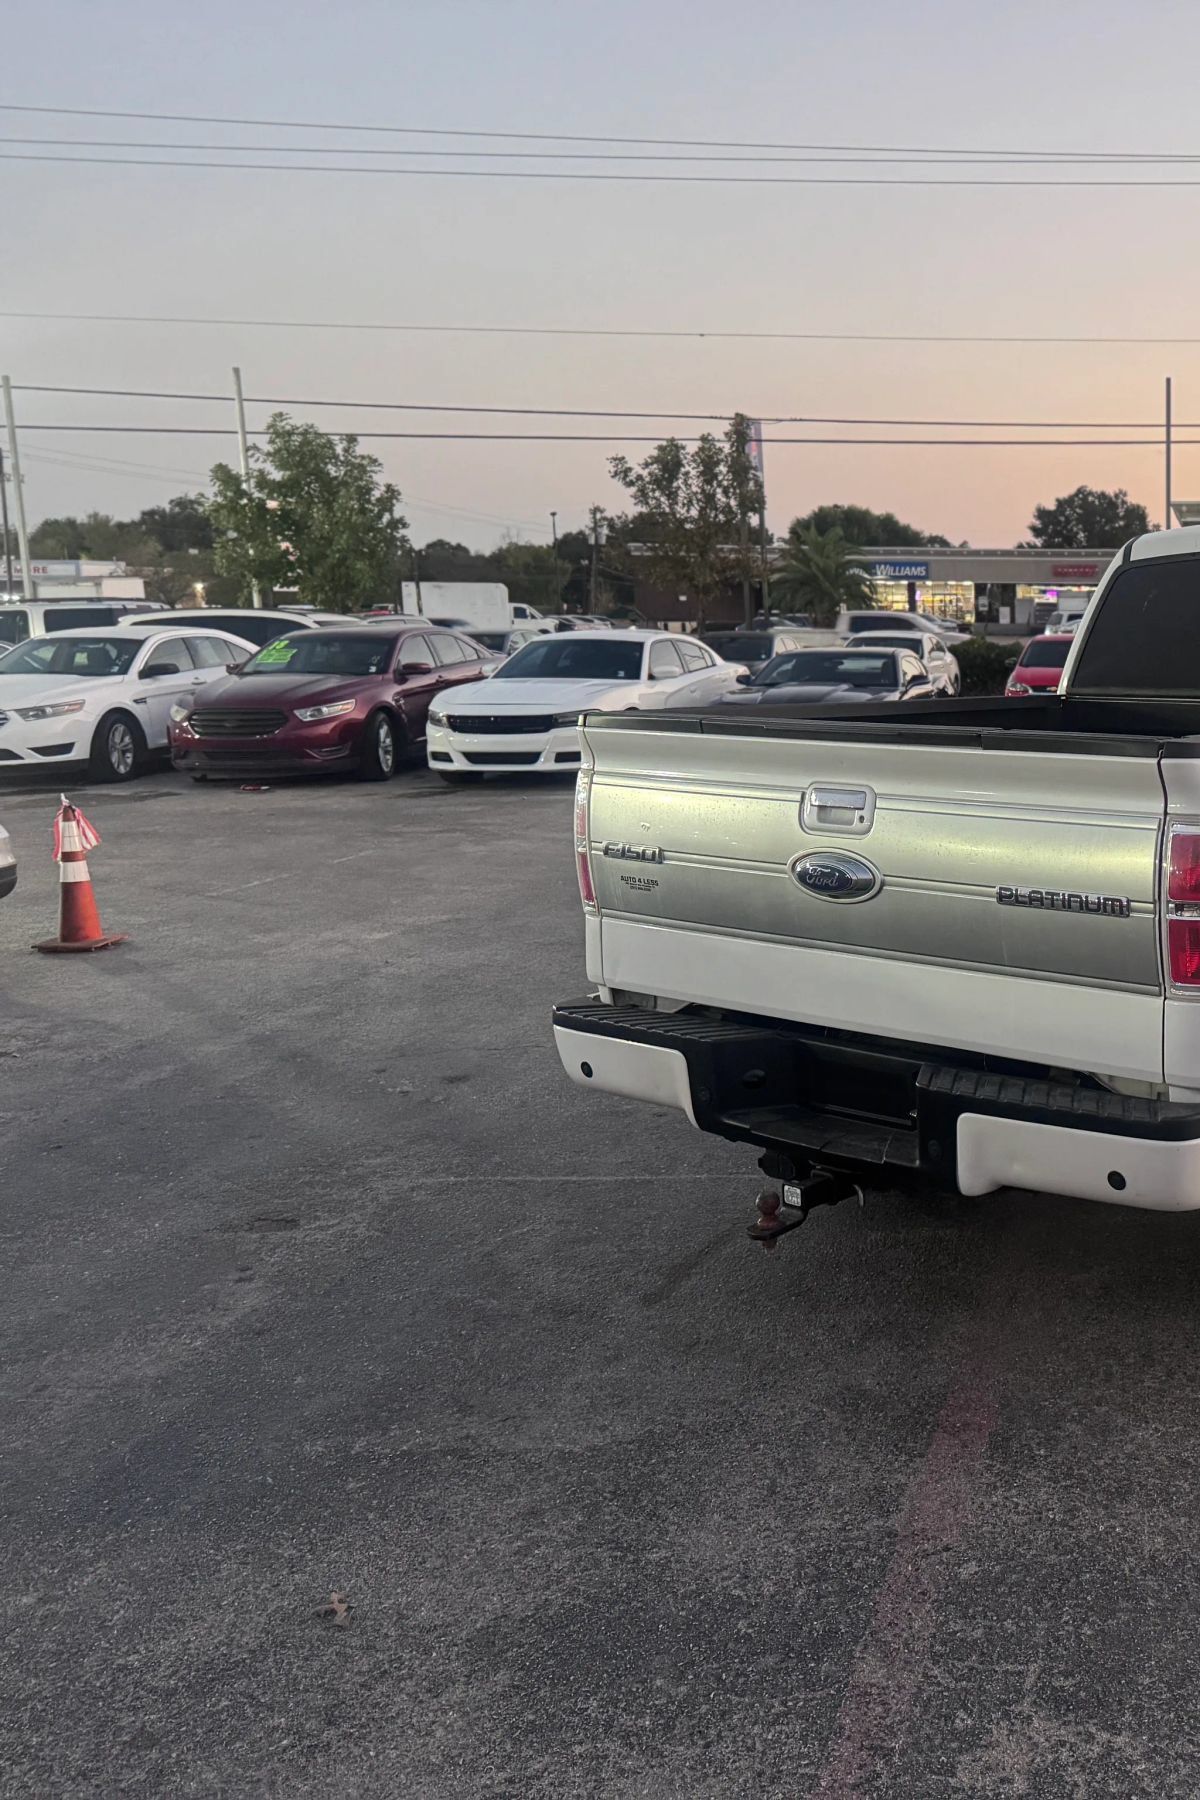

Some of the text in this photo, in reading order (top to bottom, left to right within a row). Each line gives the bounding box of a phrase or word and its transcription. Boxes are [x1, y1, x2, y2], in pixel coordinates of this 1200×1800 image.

[14, 566, 48, 574] MRE
[620, 875, 637, 884] AUTO
[643, 878, 659, 887] LESS
[806, 866, 839, 887] Ford
[998, 886, 1125, 915] PLATINUM
